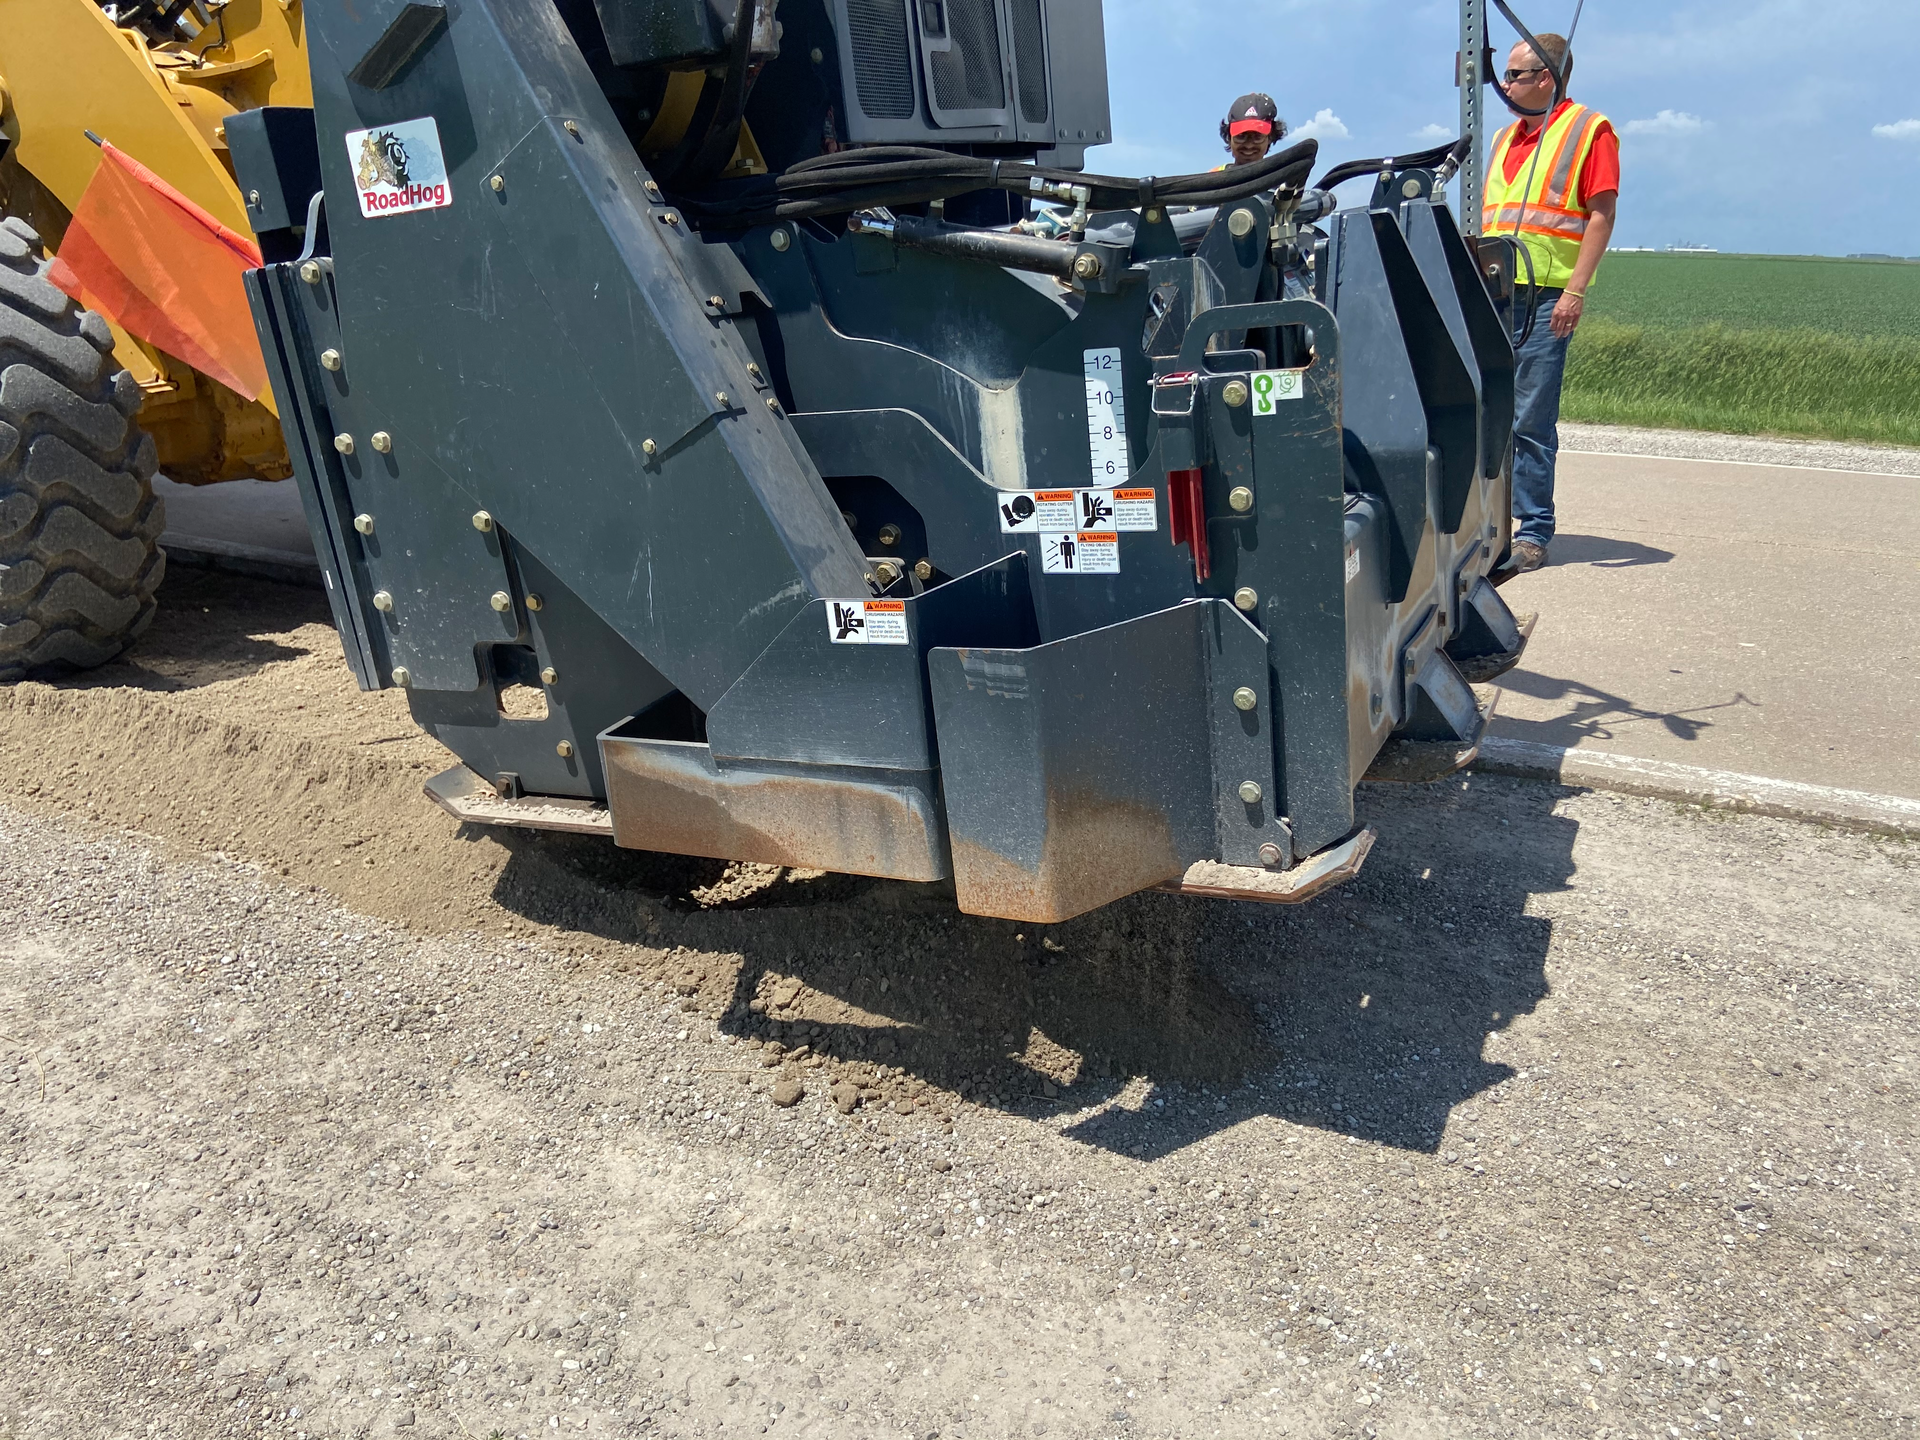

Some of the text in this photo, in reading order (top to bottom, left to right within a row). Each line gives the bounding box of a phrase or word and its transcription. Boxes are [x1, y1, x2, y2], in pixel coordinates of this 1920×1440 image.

[363, 184, 445, 211] RoadHog
[1093, 355, 1112, 370] 12
[1096, 390, 1114, 405] 10
[1103, 426, 1113, 440] 8
[1105, 460, 1115, 474] 6
